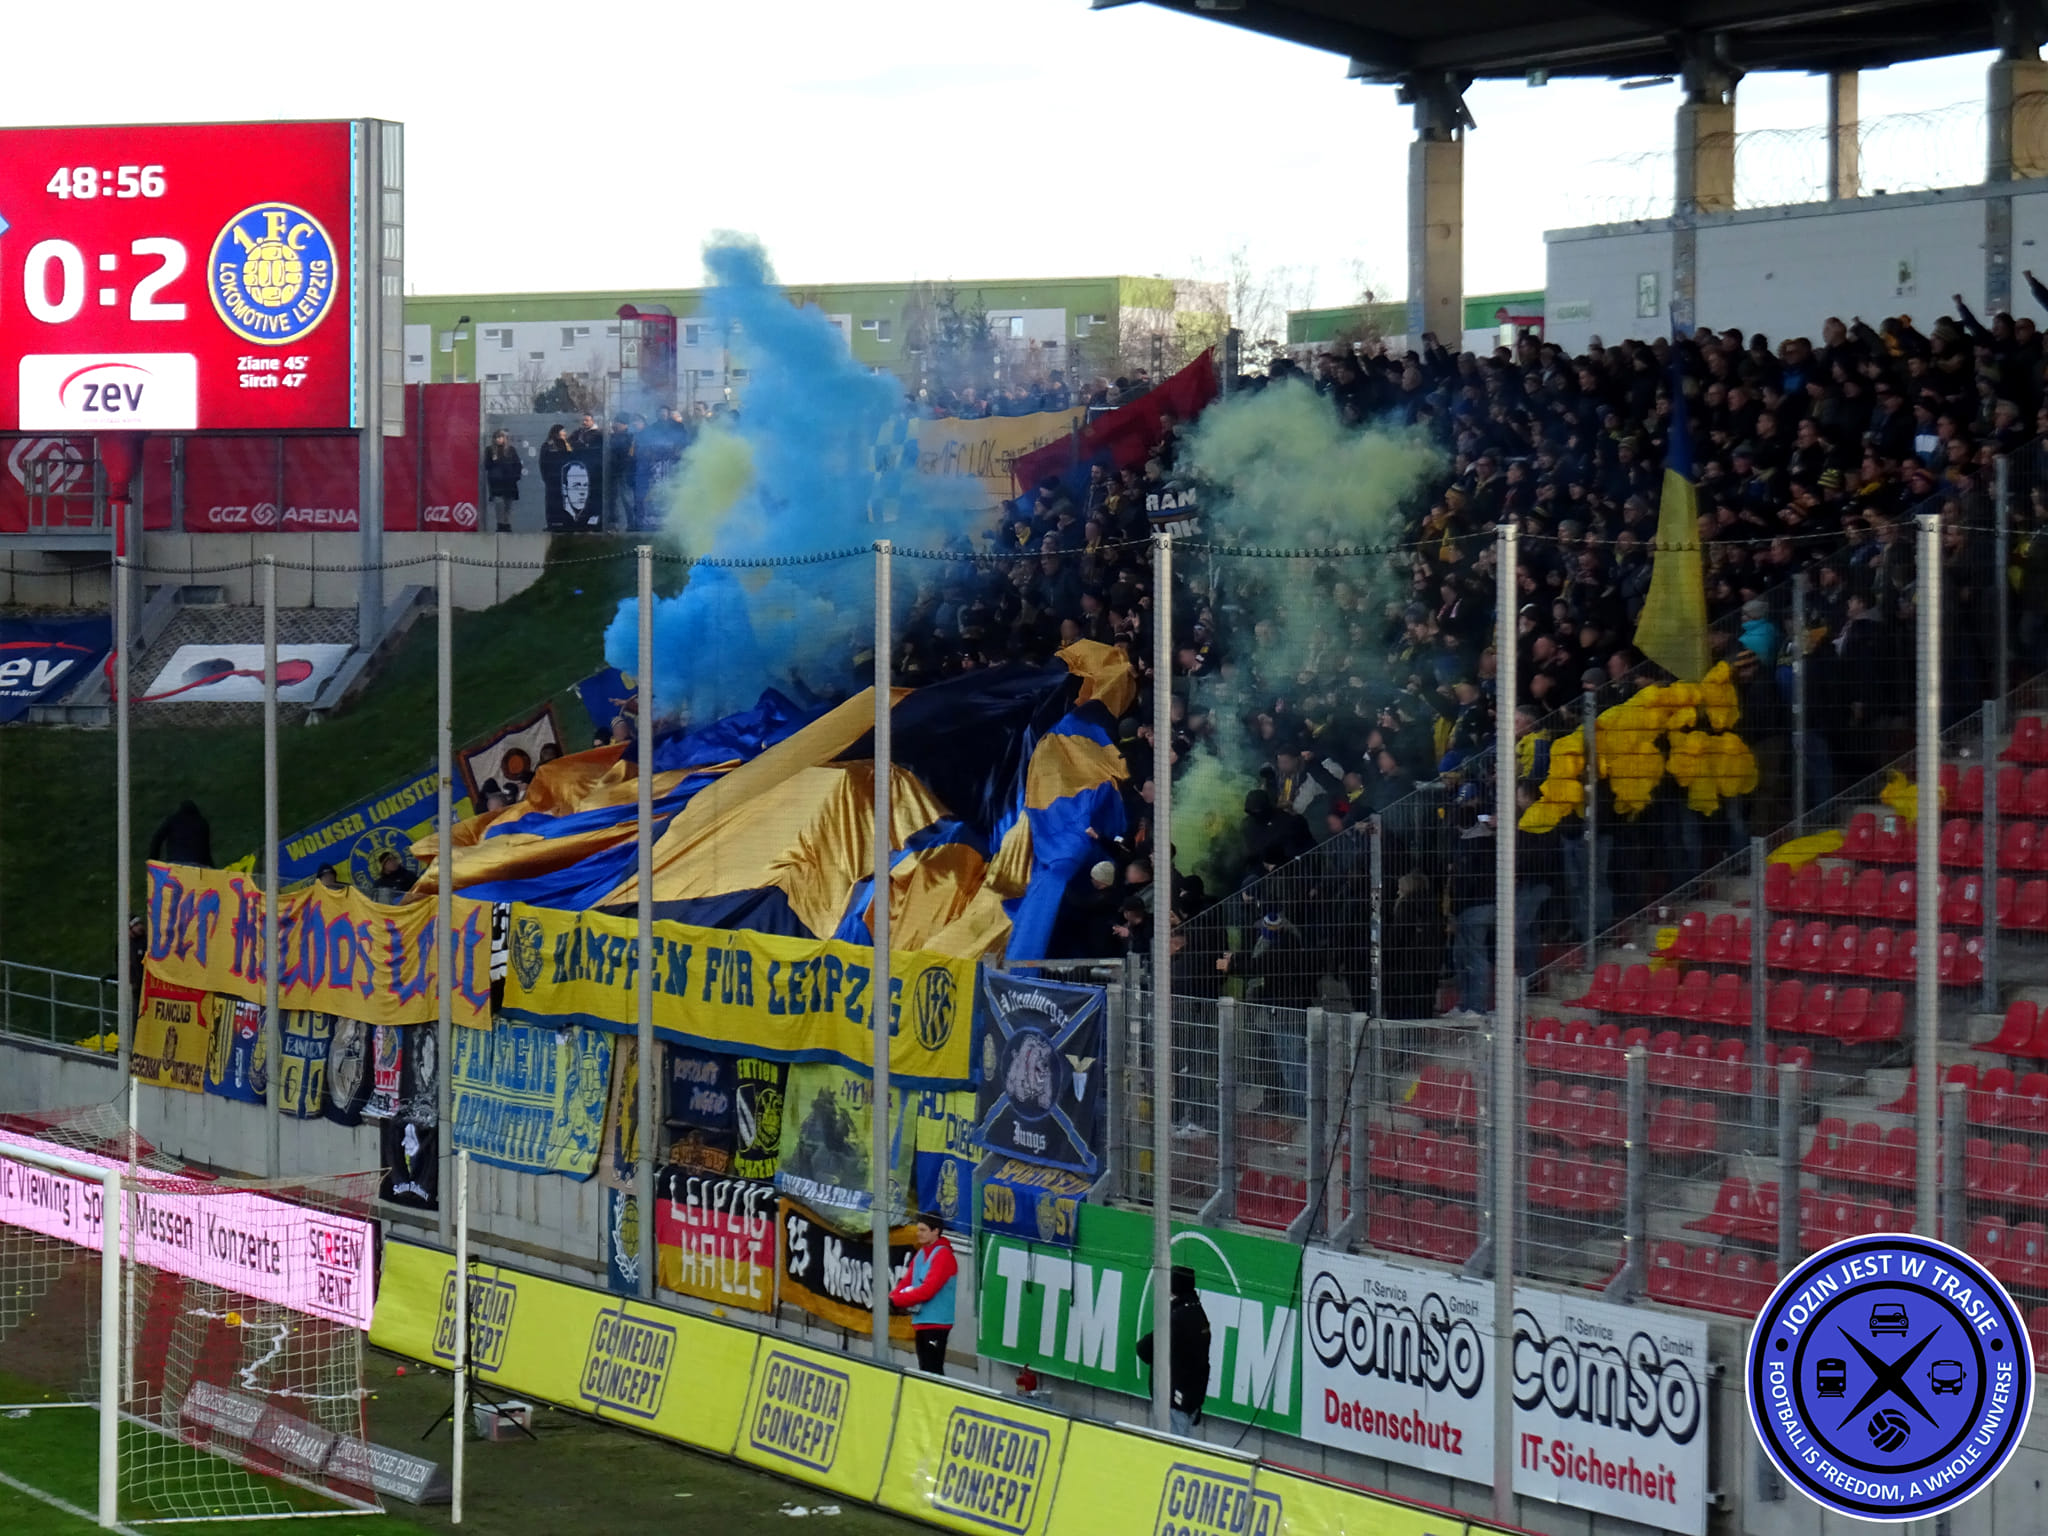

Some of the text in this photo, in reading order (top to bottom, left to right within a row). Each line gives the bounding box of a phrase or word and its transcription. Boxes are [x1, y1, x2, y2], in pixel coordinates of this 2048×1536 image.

[46, 165, 166, 199] 48:56
[218, 259, 328, 333] LOKOMOTIVE LEIPZIG
[237, 356, 309, 371] Ziane 45'
[239, 373, 306, 388] Sirch 47'
[82, 383, 144, 413] zev
[208, 506, 358, 524] GGZ ARENA
[424, 505, 450, 522] GGZ
[285, 813, 366, 862] WOLKSER
[552, 911, 692, 997] KÄMPFEN
[701, 935, 754, 1007] FÜR
[768, 954, 903, 1037] LEIPZG
[155, 1001, 191, 1023] FANCLUB
[1000, 989, 1070, 1028] Altenburger
[1013, 1121, 1046, 1154] Jungs
[17, 1163, 70, 1226] Viewing
[135, 1193, 193, 1250] Messen
[206, 1212, 281, 1276] Konzerte
[670, 1174, 774, 1240] LEIPZIG
[310, 1228, 359, 1270] SCREEN
[682, 1229, 762, 1299] HALLE
[318, 1271, 352, 1310] RENT
[997, 1246, 1123, 1373] TTM
[1362, 1278, 1408, 1301] IT-Service
[1449, 1295, 1479, 1317] GmbH
[596, 1318, 669, 1371] COMEDIA
[1564, 1316, 1614, 1341] IT-Service
[1660, 1335, 1695, 1358] GmbH
[1195, 1288, 1297, 1416] TM
[586, 1356, 661, 1409] CONCEPT
[766, 1361, 844, 1421] COMEDIA
[756, 1403, 836, 1464] CONCEPT
[1324, 1388, 1464, 1456] Datenschutz
[398, 1455, 430, 1482] FOLIEN
[950, 1417, 1041, 1481] COMEDIA
[1520, 1432, 1677, 1504] IT-Sicherheit
[940, 1461, 1032, 1525] CONCEPT
